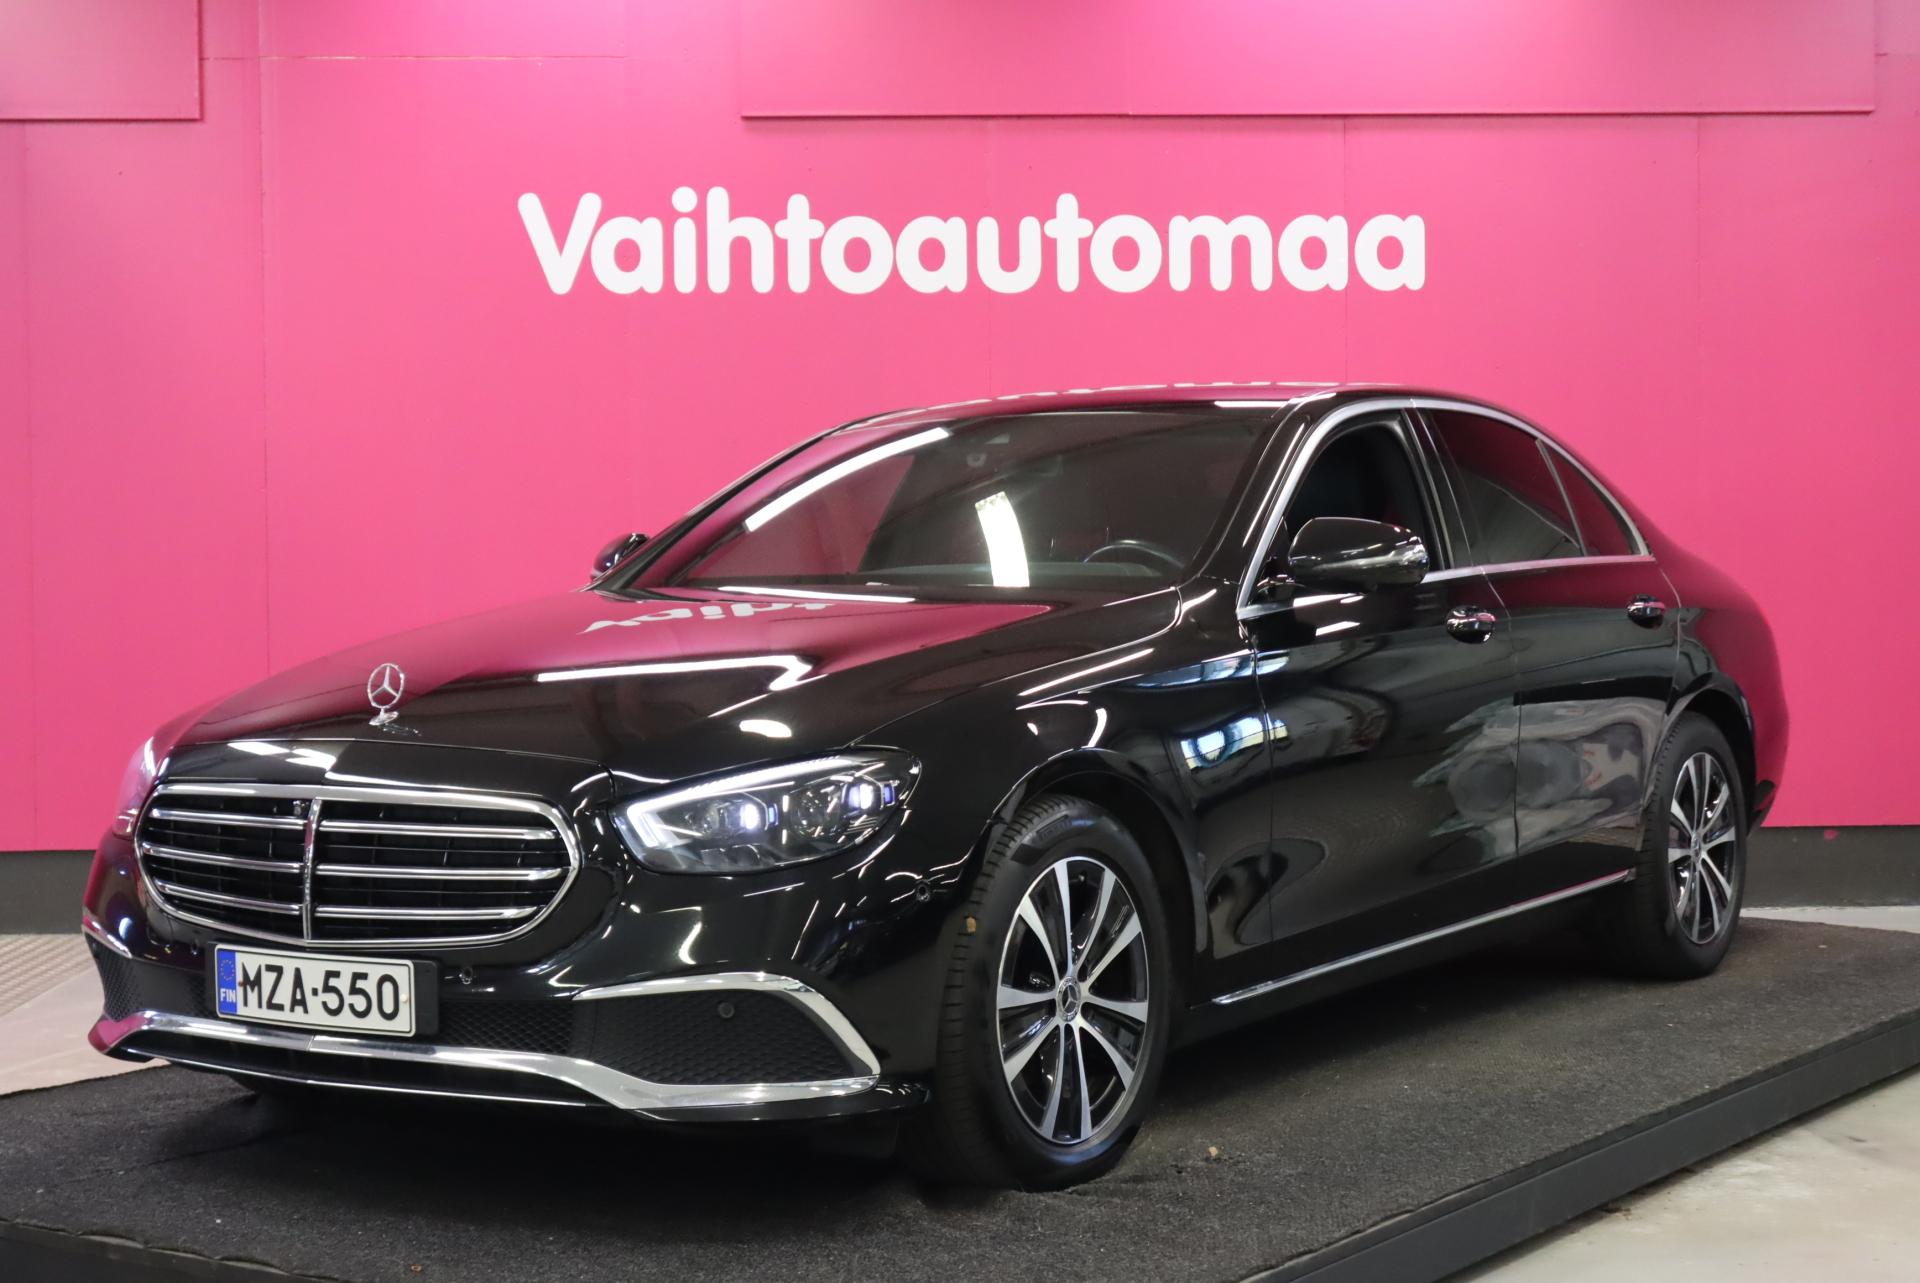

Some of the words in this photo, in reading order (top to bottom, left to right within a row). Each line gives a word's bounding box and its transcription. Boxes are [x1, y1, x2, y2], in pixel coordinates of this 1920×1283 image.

[517, 186, 1427, 295] Vaihtoautomaa
[220, 988, 236, 1003] FIN
[241, 961, 400, 1021] MZA-550
